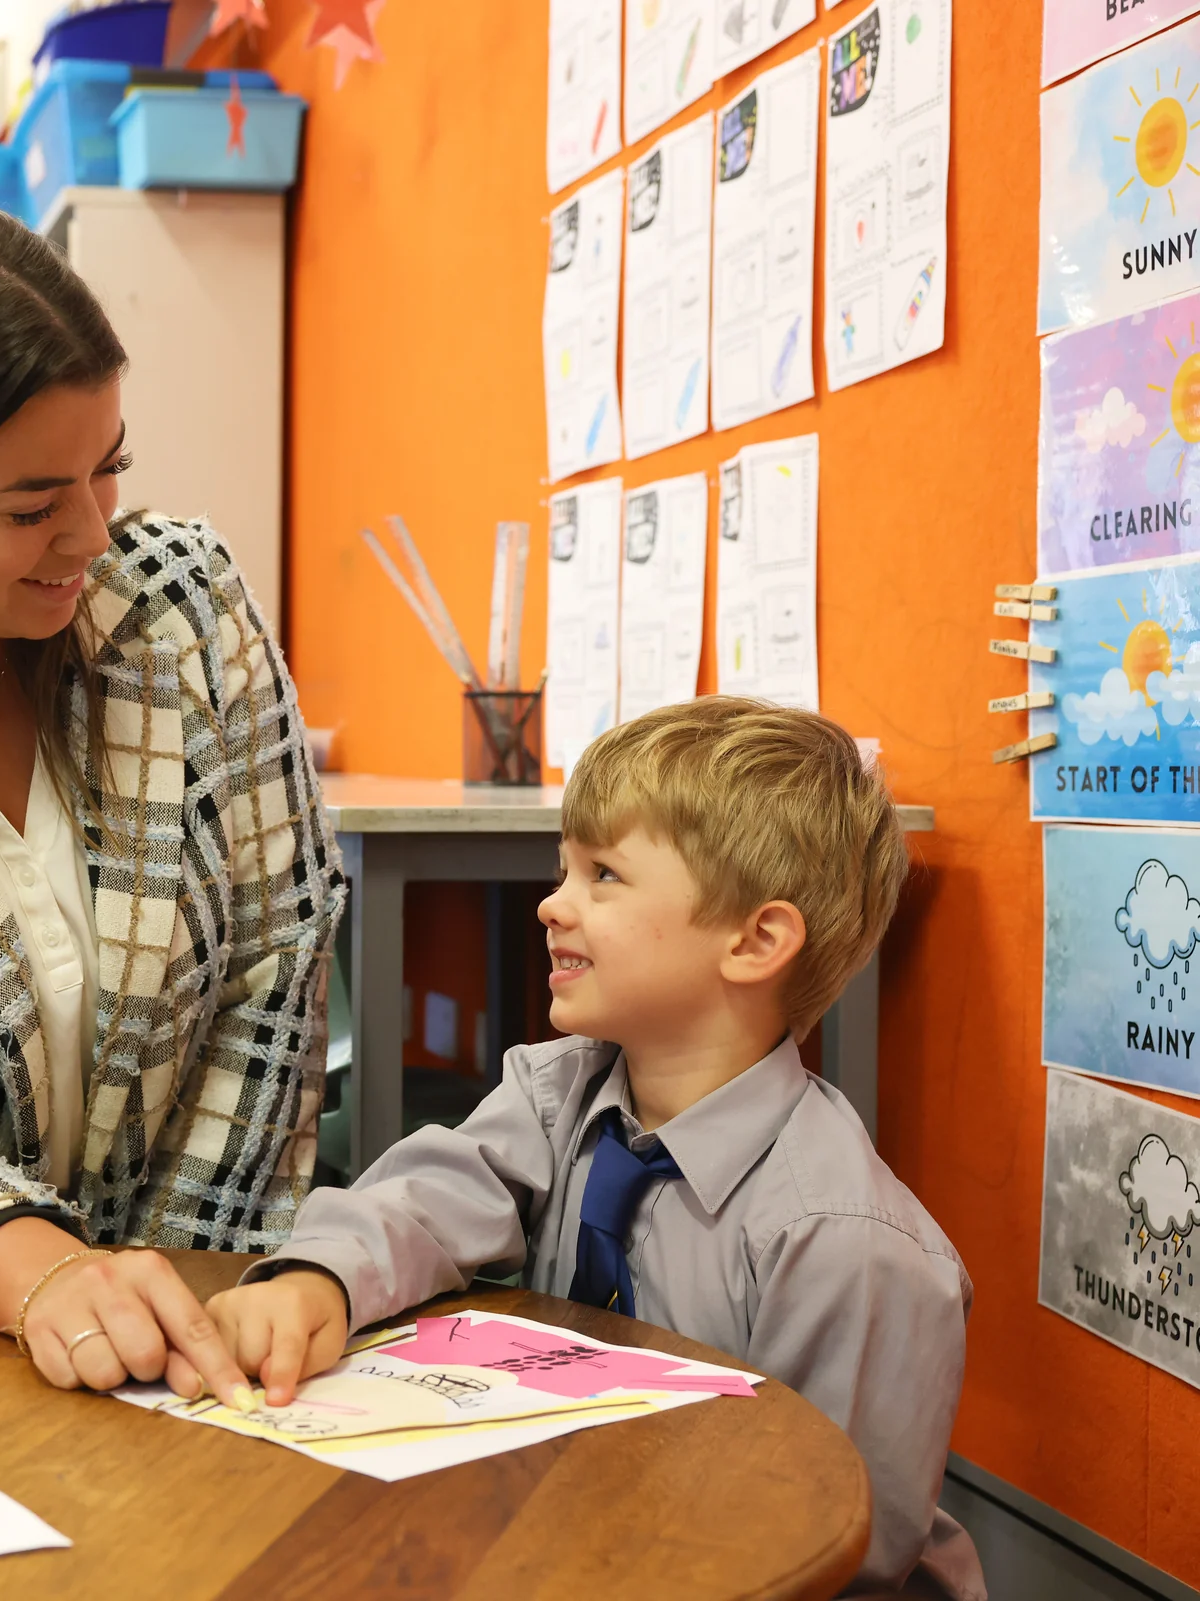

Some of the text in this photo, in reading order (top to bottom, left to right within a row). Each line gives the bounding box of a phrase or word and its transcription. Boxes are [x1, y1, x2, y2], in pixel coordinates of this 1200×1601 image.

[1122, 228, 1198, 280] SUNNY
[1090, 499, 1192, 542] CLEARING
[1056, 765, 1200, 794] START OF TH
[1127, 1021, 1196, 1060] RAINY
